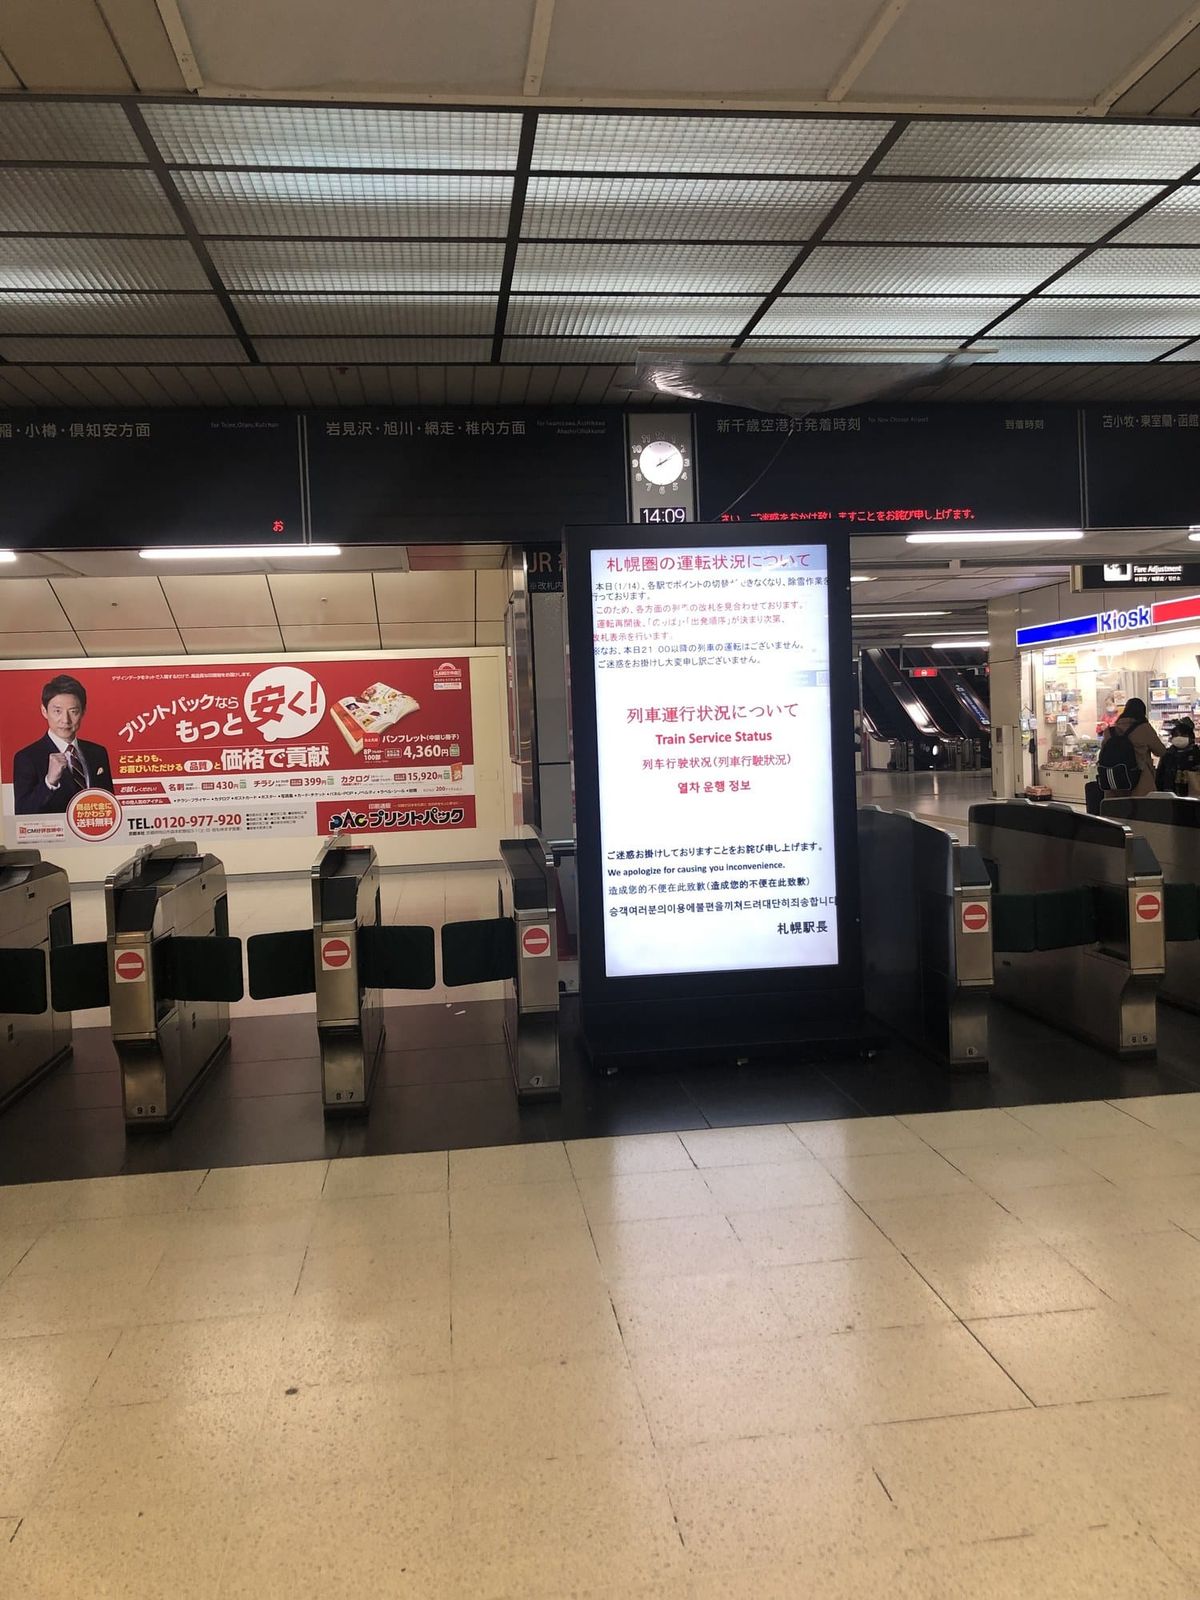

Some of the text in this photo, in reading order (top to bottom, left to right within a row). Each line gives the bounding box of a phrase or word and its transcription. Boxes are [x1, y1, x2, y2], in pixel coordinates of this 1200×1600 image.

[325, 420, 527, 436] 岩見沢・旭川・網走・稚内方面
[716, 417, 861, 433] 新千歳空港行発着時刻
[632, 444, 643, 453] 10
[680, 444, 687, 453] 2
[631, 459, 639, 468] 9
[683, 458, 691, 467] 3
[680, 471, 688, 480] 4
[645, 482, 653, 492] 7
[658, 485, 666, 495] 6
[672, 482, 679, 491] 5
[642, 508, 686, 523] 14:09
[272, 520, 285, 533] お
[528, 552, 552, 572] JR
[606, 553, 811, 573] 札幌圏の運転状況について
[1133, 565, 1182, 575] Fare Adjustment
[1100, 606, 1150, 632] Kiosk
[118, 693, 240, 744] プリントパックなら
[626, 702, 800, 724] 列車運行状況について
[175, 712, 244, 744] もっと
[655, 730, 773, 745] Train Service Status
[119, 754, 163, 764] どこよりも、
[189, 761, 209, 771] 品質
[214, 762, 222, 771] と
[221, 745, 330, 771] 価格で貢献
[403, 744, 449, 760] 4,360円
[253, 779, 275, 788] チラシ
[340, 775, 370, 784] カタログ
[678, 780, 752, 794] 열차 운행 정보
[76, 817, 113, 828] 送料無料
[369, 807, 464, 828] プリントパック
[607, 842, 822, 860] ご迷惑お掛けしておりますことをお詫び申し上げます。
[607, 861, 786, 877] We apologize for causing you inconvenience.
[777, 921, 829, 936] 札幌駅長
